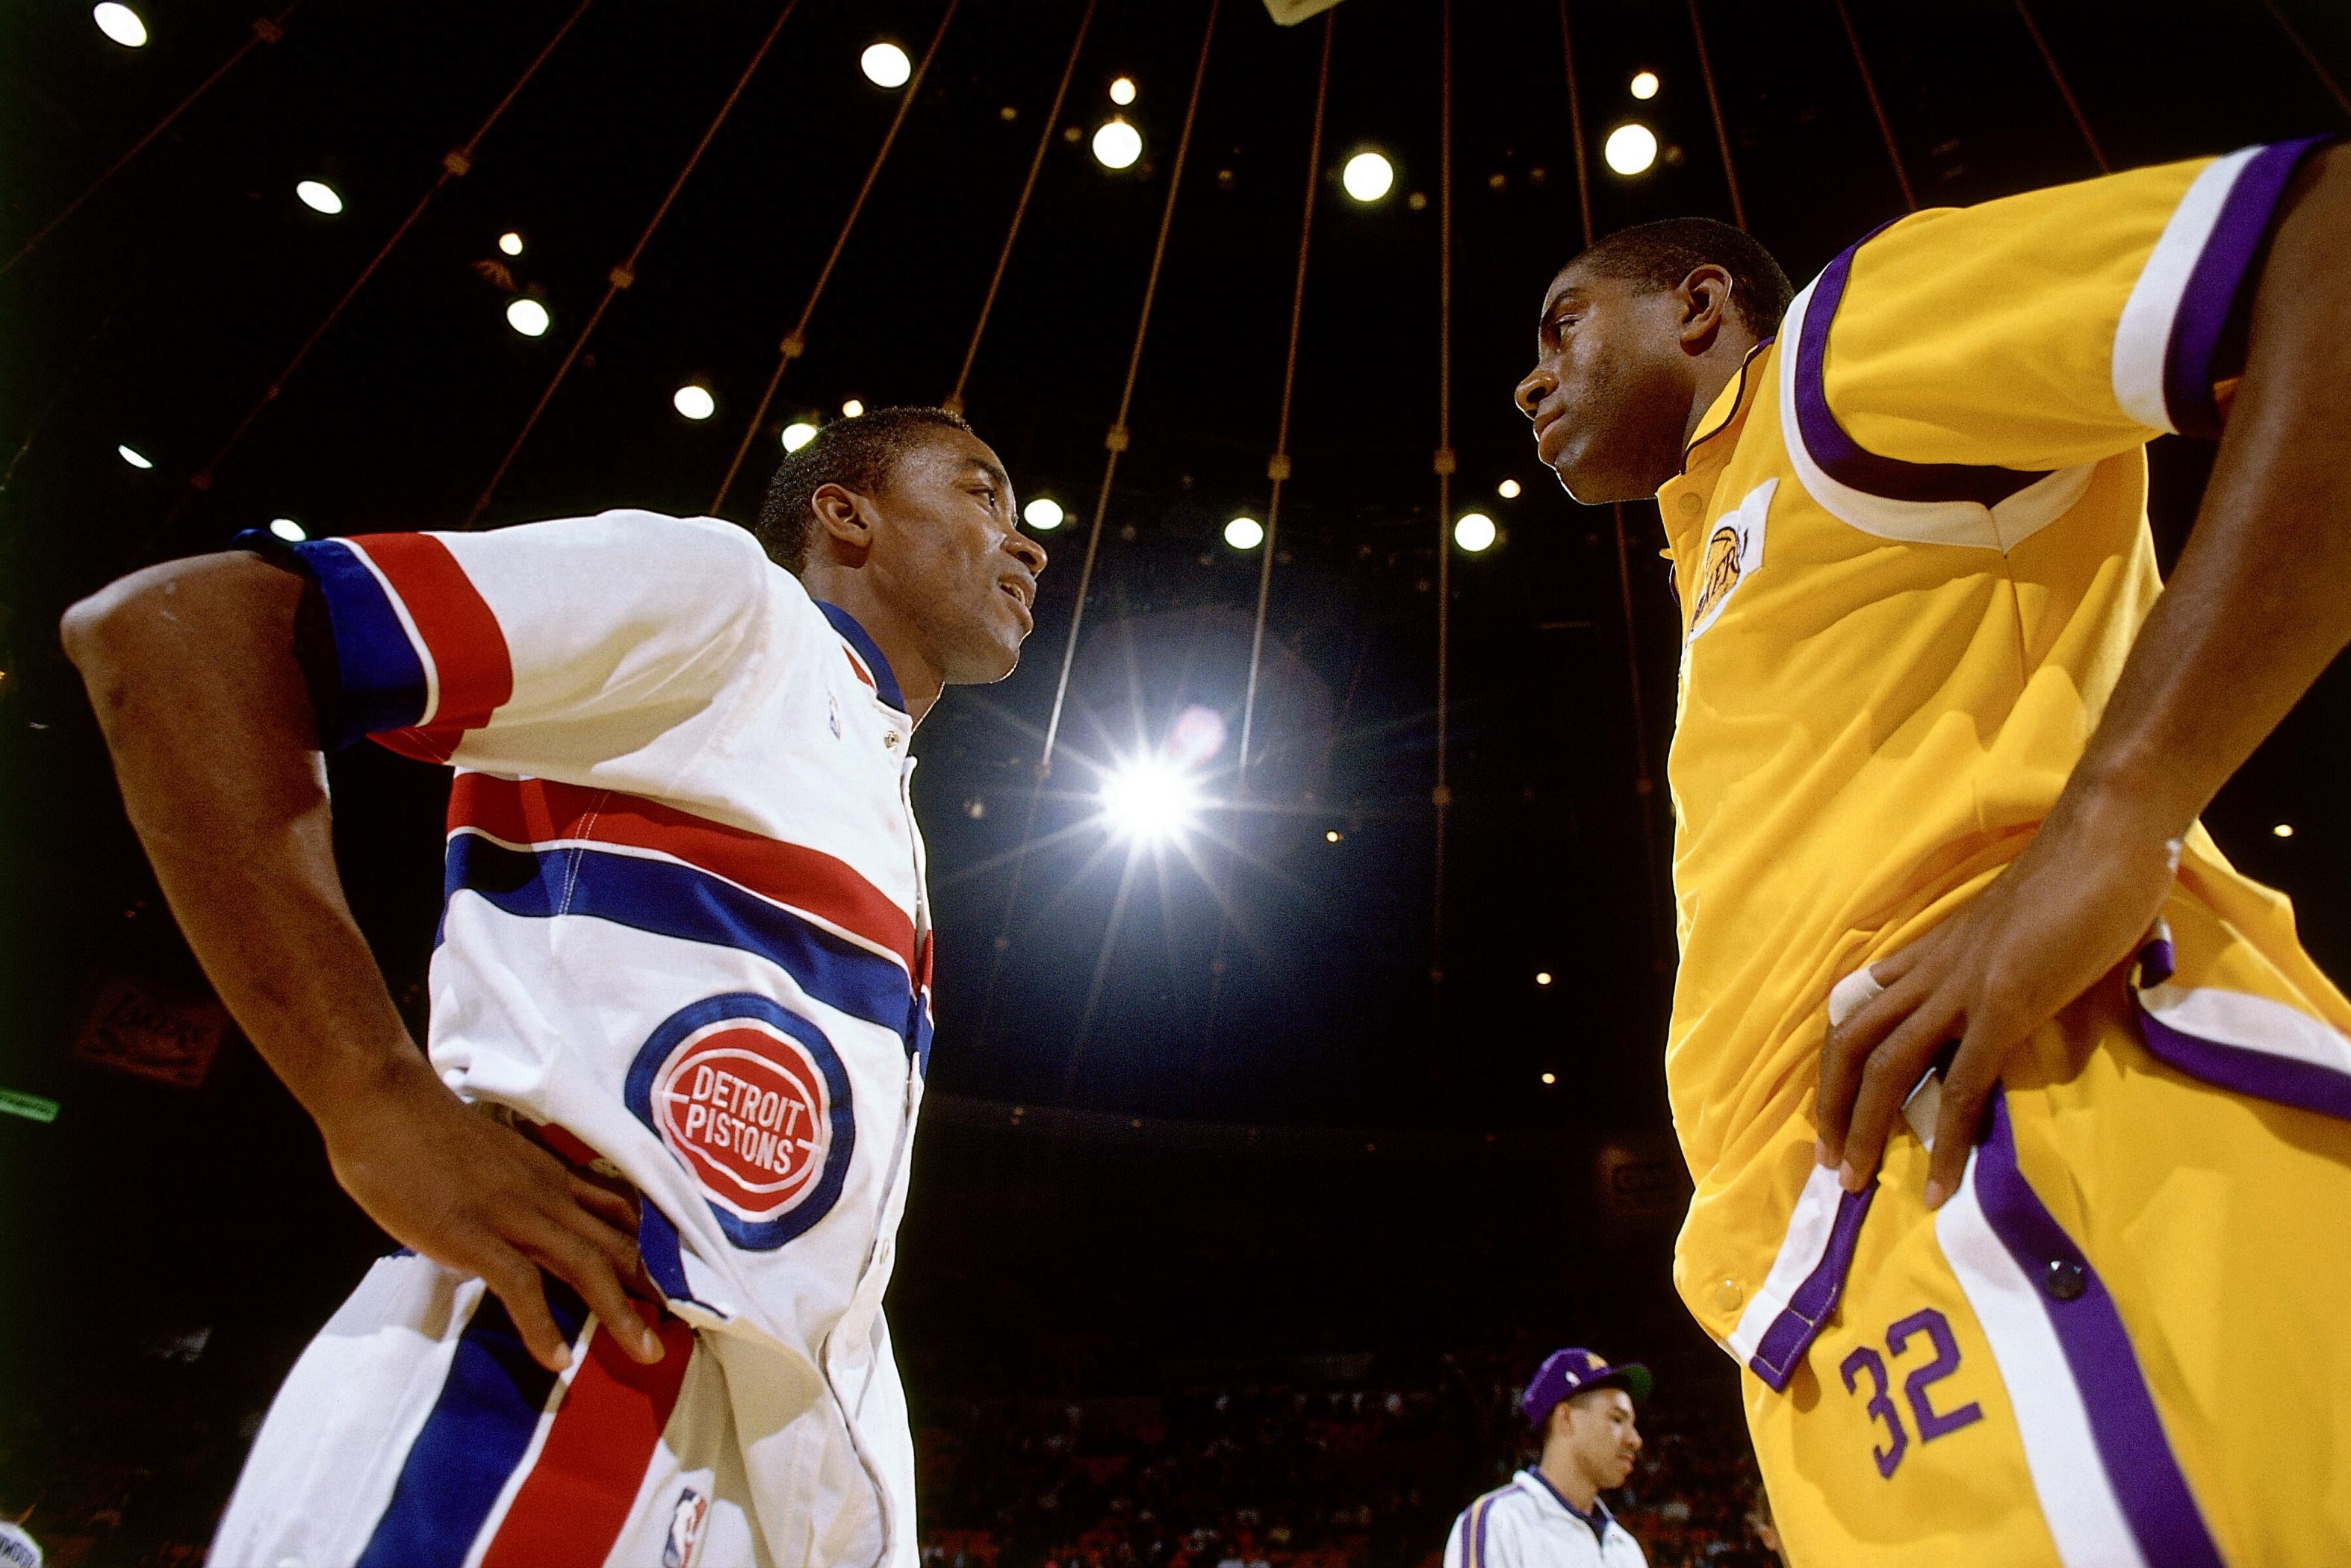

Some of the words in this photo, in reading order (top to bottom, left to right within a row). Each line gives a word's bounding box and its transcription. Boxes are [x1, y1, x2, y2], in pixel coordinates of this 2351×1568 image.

[691, 1065, 805, 1136] DETROIT
[686, 1104, 795, 1175] PISTONS
[1839, 1307, 1986, 1480] 32
